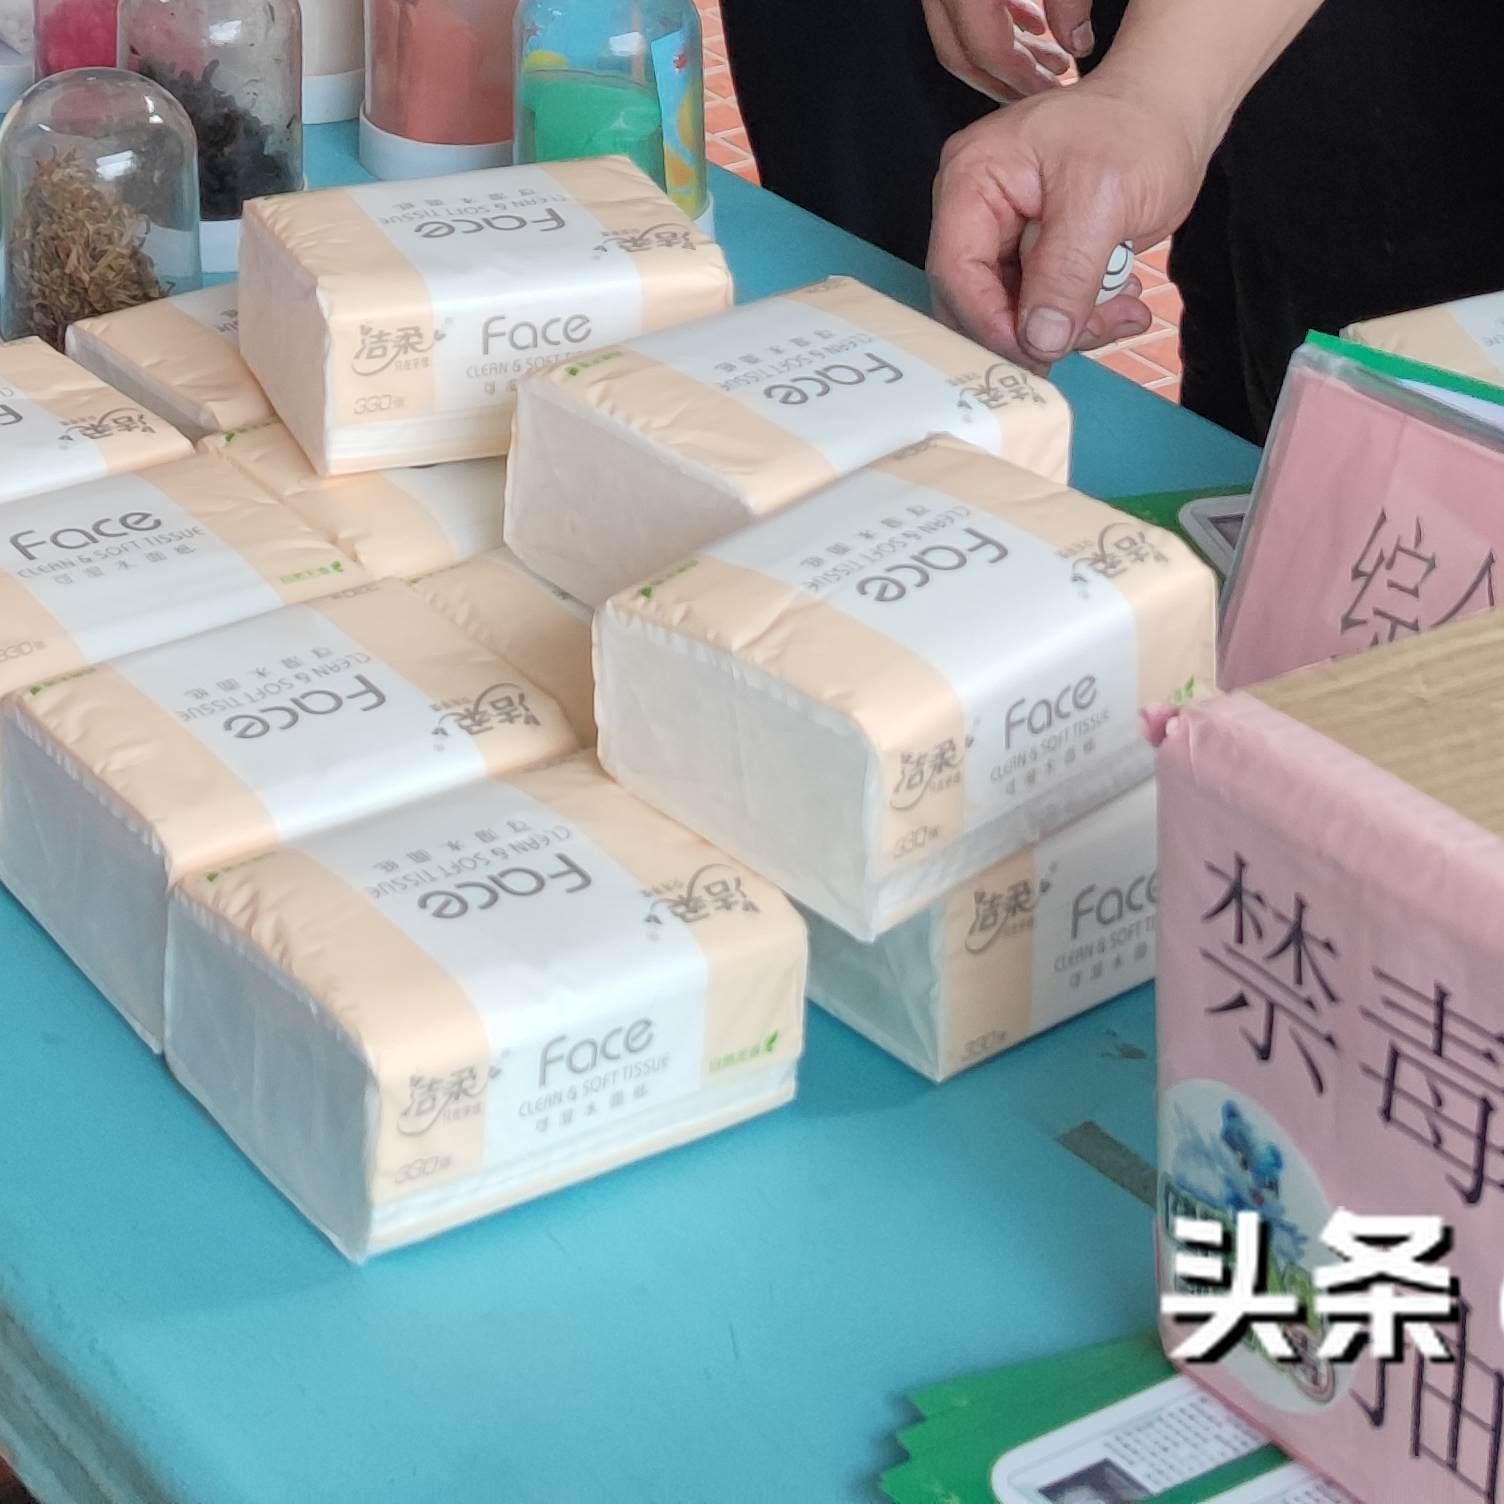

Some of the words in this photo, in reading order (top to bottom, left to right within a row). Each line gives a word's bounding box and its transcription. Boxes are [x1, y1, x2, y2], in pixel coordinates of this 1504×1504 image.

[414, 207, 566, 238] Face
[354, 325, 424, 361] 洁柔
[482, 314, 592, 355] Face
[763, 351, 904, 405] Face
[8, 511, 161, 561] Face
[857, 527, 1009, 602] Face
[222, 673, 387, 740] Face
[1004, 674, 1097, 749] Face
[417, 852, 592, 920] Face
[539, 1018, 654, 1087] Face
